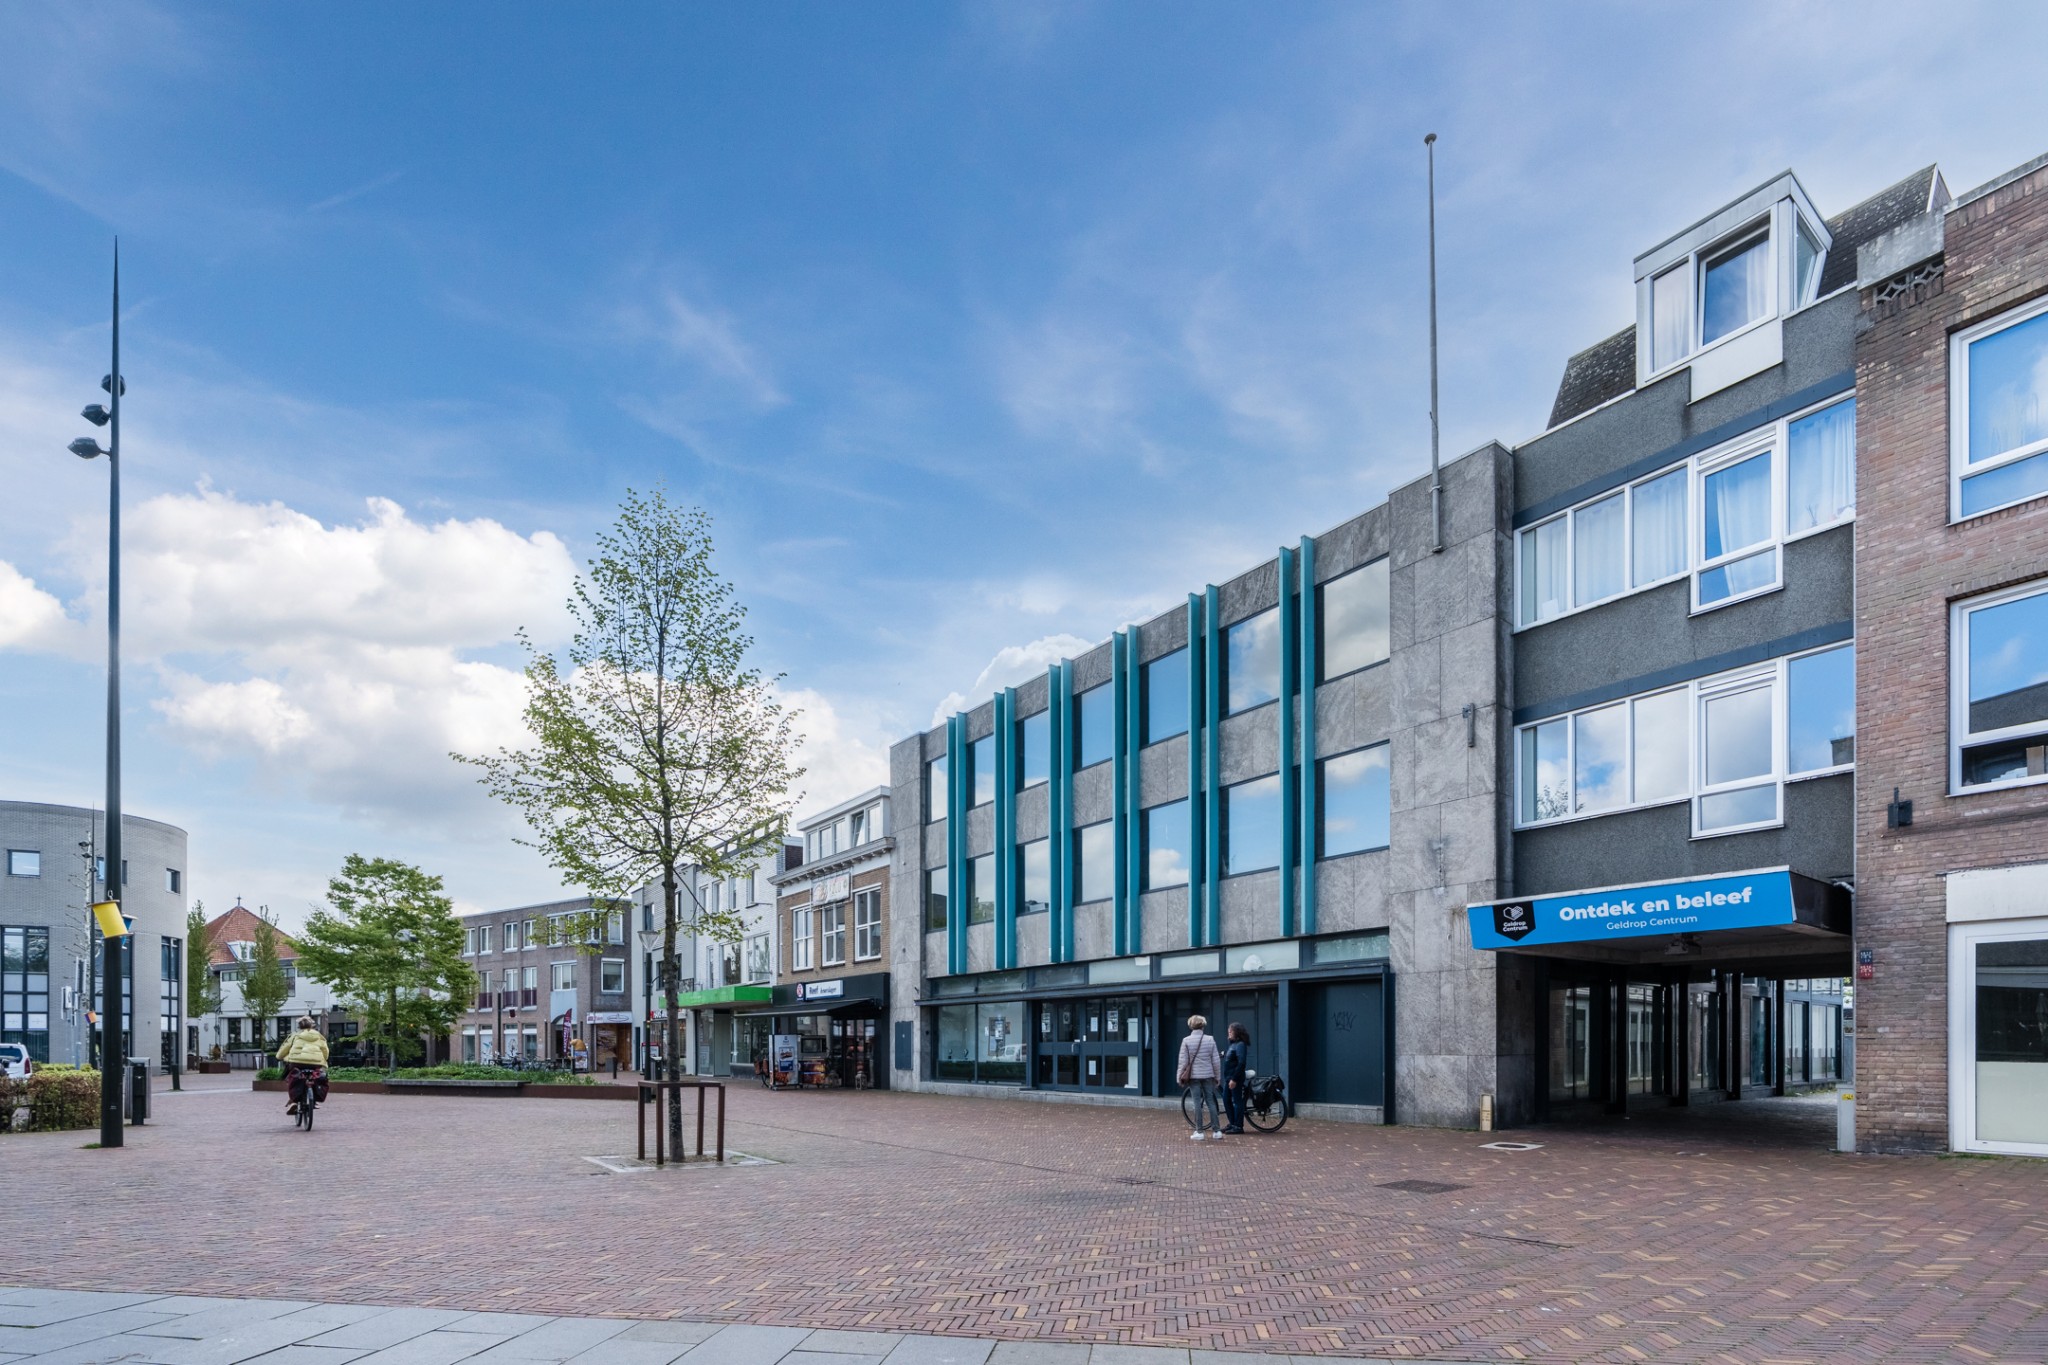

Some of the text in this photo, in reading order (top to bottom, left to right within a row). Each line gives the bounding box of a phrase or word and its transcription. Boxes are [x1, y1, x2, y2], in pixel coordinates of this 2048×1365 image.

[1559, 887, 1753, 921] Ontdek en beleef
[1606, 916, 1698, 930] Geldrop Centrum
